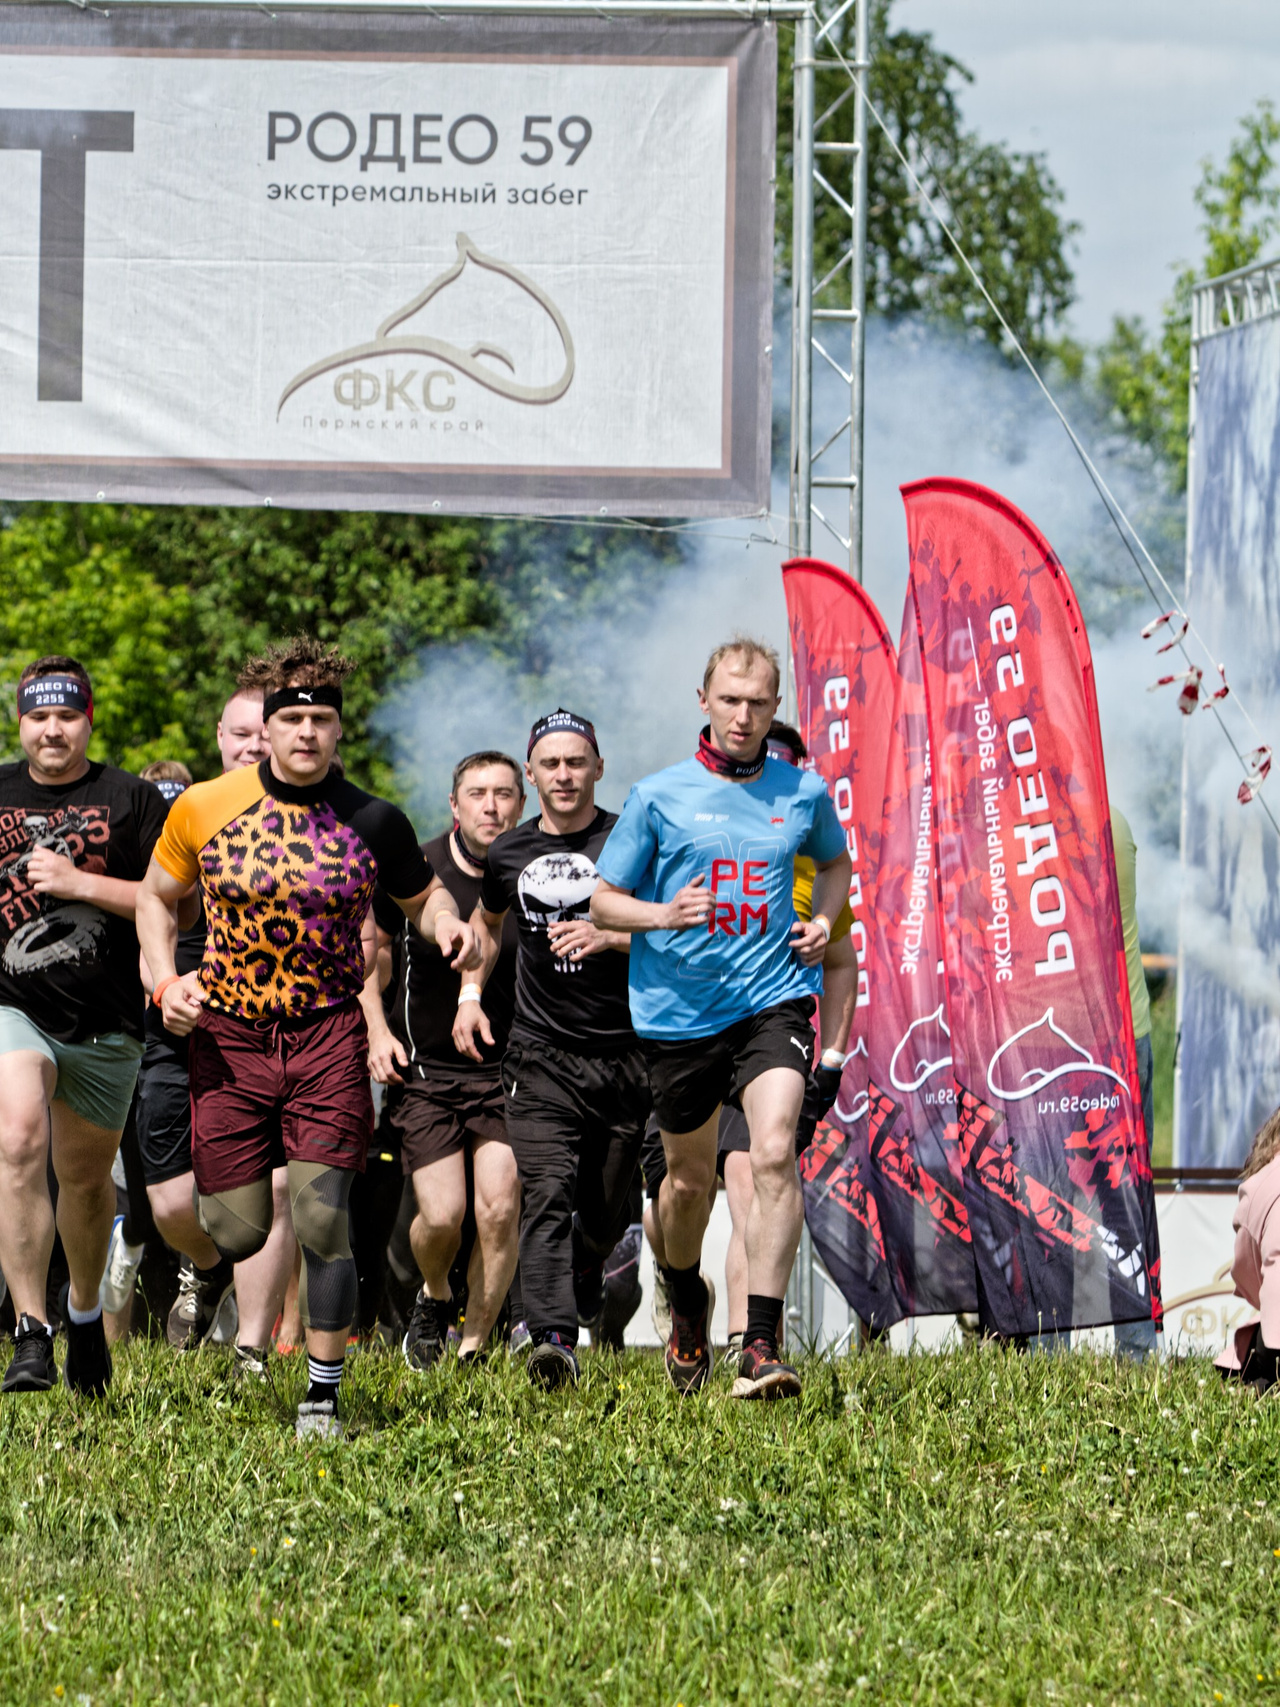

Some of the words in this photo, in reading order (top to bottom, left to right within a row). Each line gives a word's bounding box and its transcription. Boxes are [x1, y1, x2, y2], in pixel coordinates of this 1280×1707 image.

[266, 110, 498, 172] РОДЕО
[520, 114, 593, 167] 59
[266, 181, 497, 207] экстремальный
[506, 183, 589, 206] забег
[333, 368, 456, 413] ФКС
[303, 415, 419, 432] Пермский
[429, 417, 484, 432] край
[24, 681, 62, 697] РОДЕО
[35, 693, 65, 705] 2255
[710, 858, 769, 896] PE
[707, 902, 769, 936] RM
[1181, 1303, 1260, 1339] ФК
